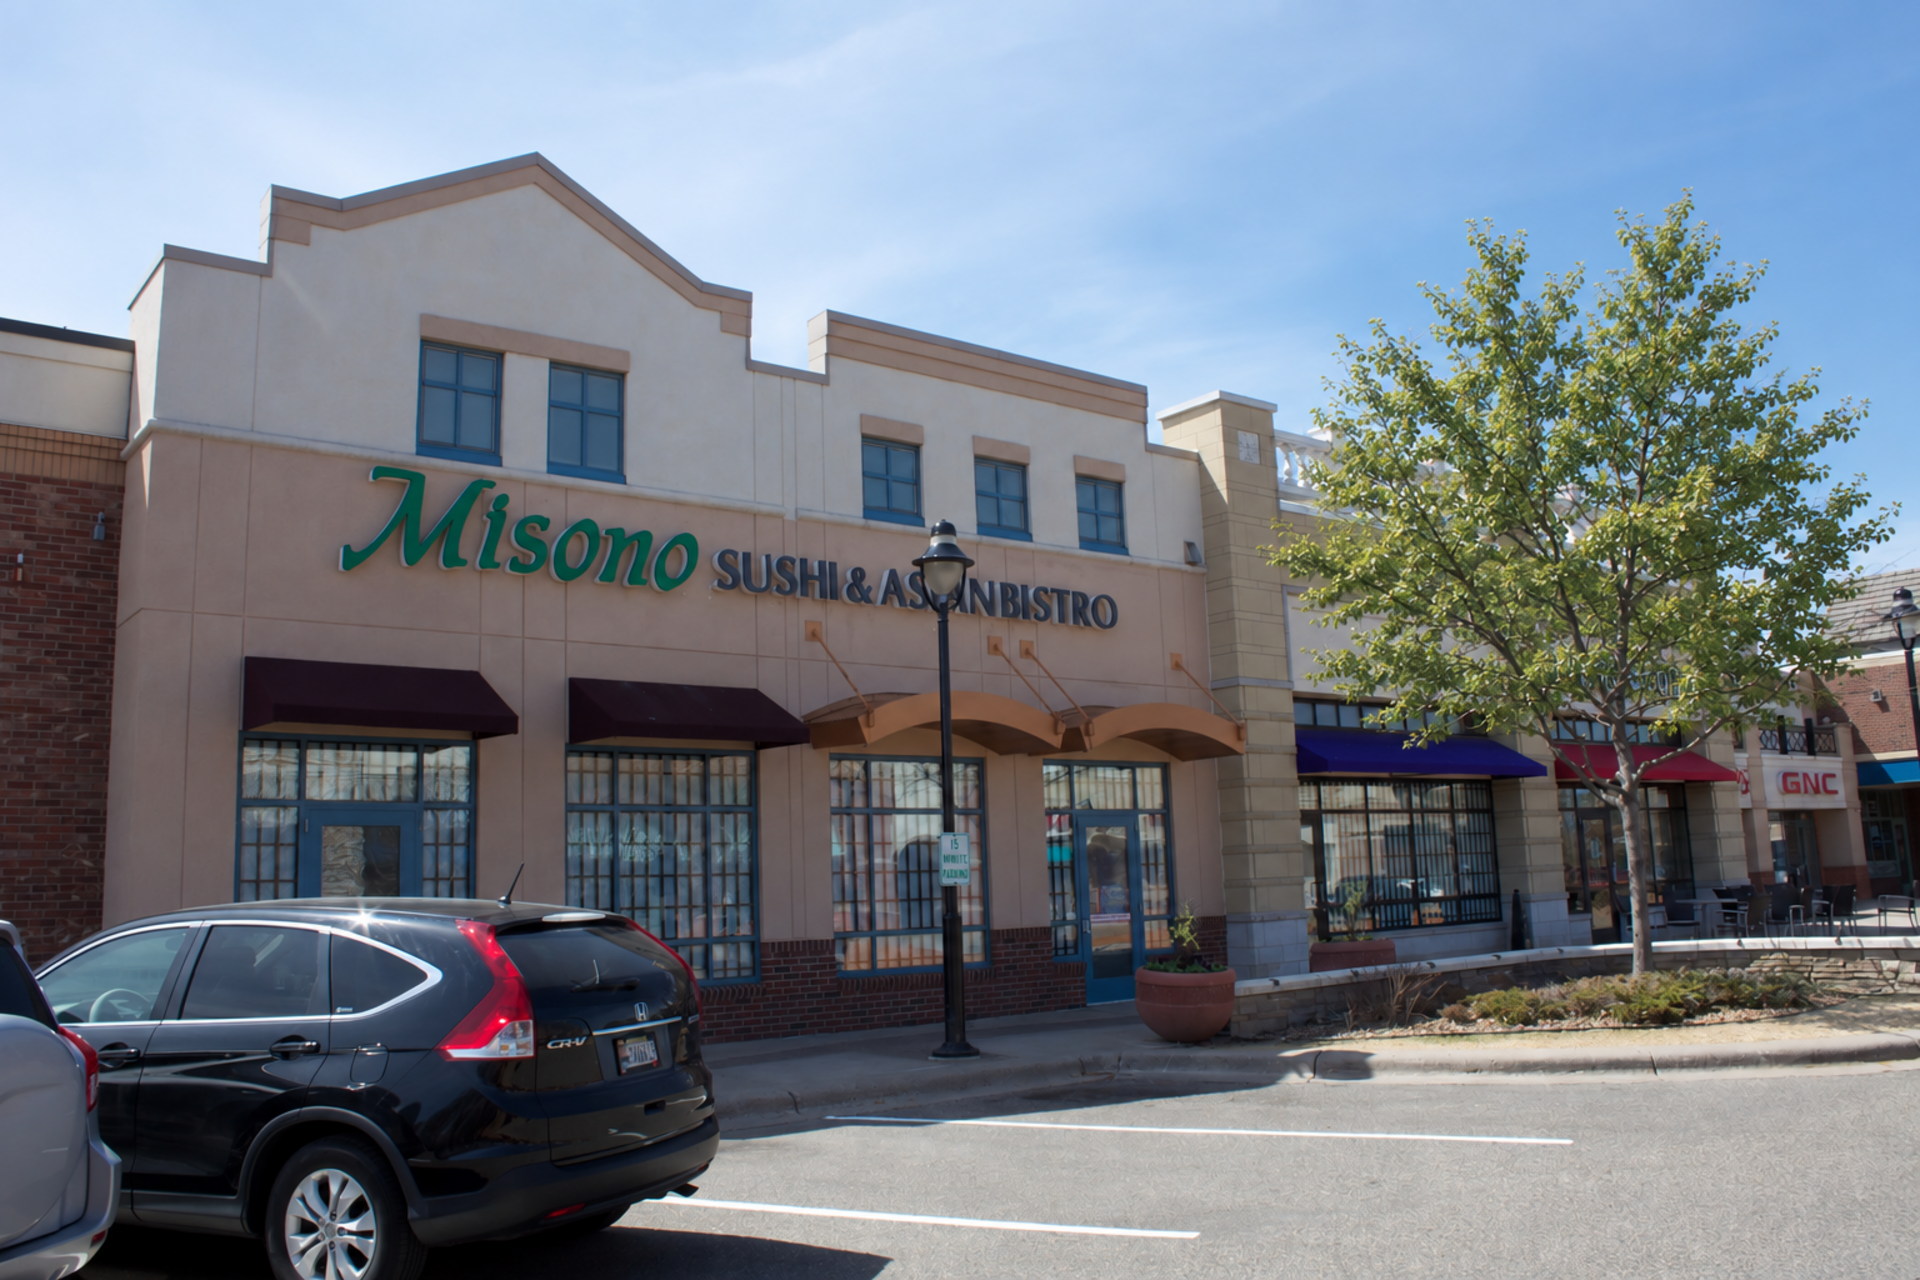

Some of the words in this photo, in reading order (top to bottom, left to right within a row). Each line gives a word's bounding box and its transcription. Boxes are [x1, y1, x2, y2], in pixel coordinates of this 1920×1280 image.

[339, 466, 699, 592] Misono
[711, 548, 839, 601] SUSHI
[842, 566, 873, 605] &
[876, 568, 995, 618] ASN
[996, 581, 1118, 630] BISTRO
[1780, 771, 1839, 795] GNC
[950, 838, 960, 850] 15
[547, 1036, 587, 1049] CR-V
